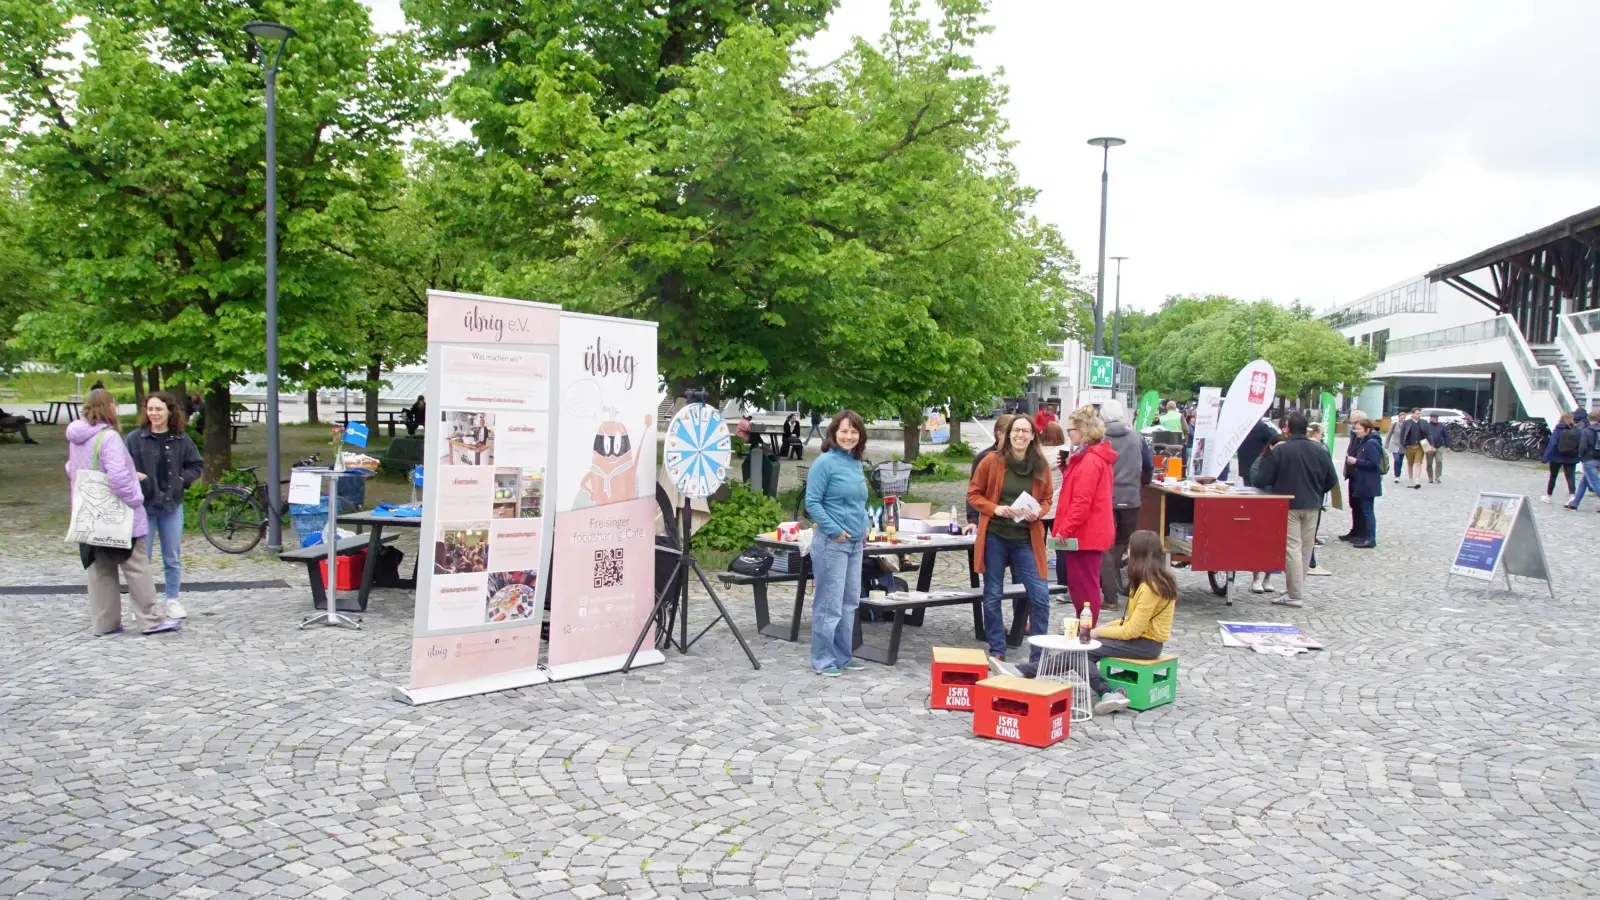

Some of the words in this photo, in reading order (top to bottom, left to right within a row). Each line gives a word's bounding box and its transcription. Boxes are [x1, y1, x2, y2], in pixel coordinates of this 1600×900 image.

[464, 305, 505, 342] übrig
[508, 317, 530, 333] e.V.
[472, 352, 485, 361] Was
[486, 354, 508, 362] machen
[584, 336, 639, 391] übrig
[589, 517, 630, 529] Freisinger
[949, 687, 969, 697] ISAR
[946, 695, 971, 707] KINDL
[998, 715, 1019, 729] ISAR
[996, 724, 1021, 739] KINDL
